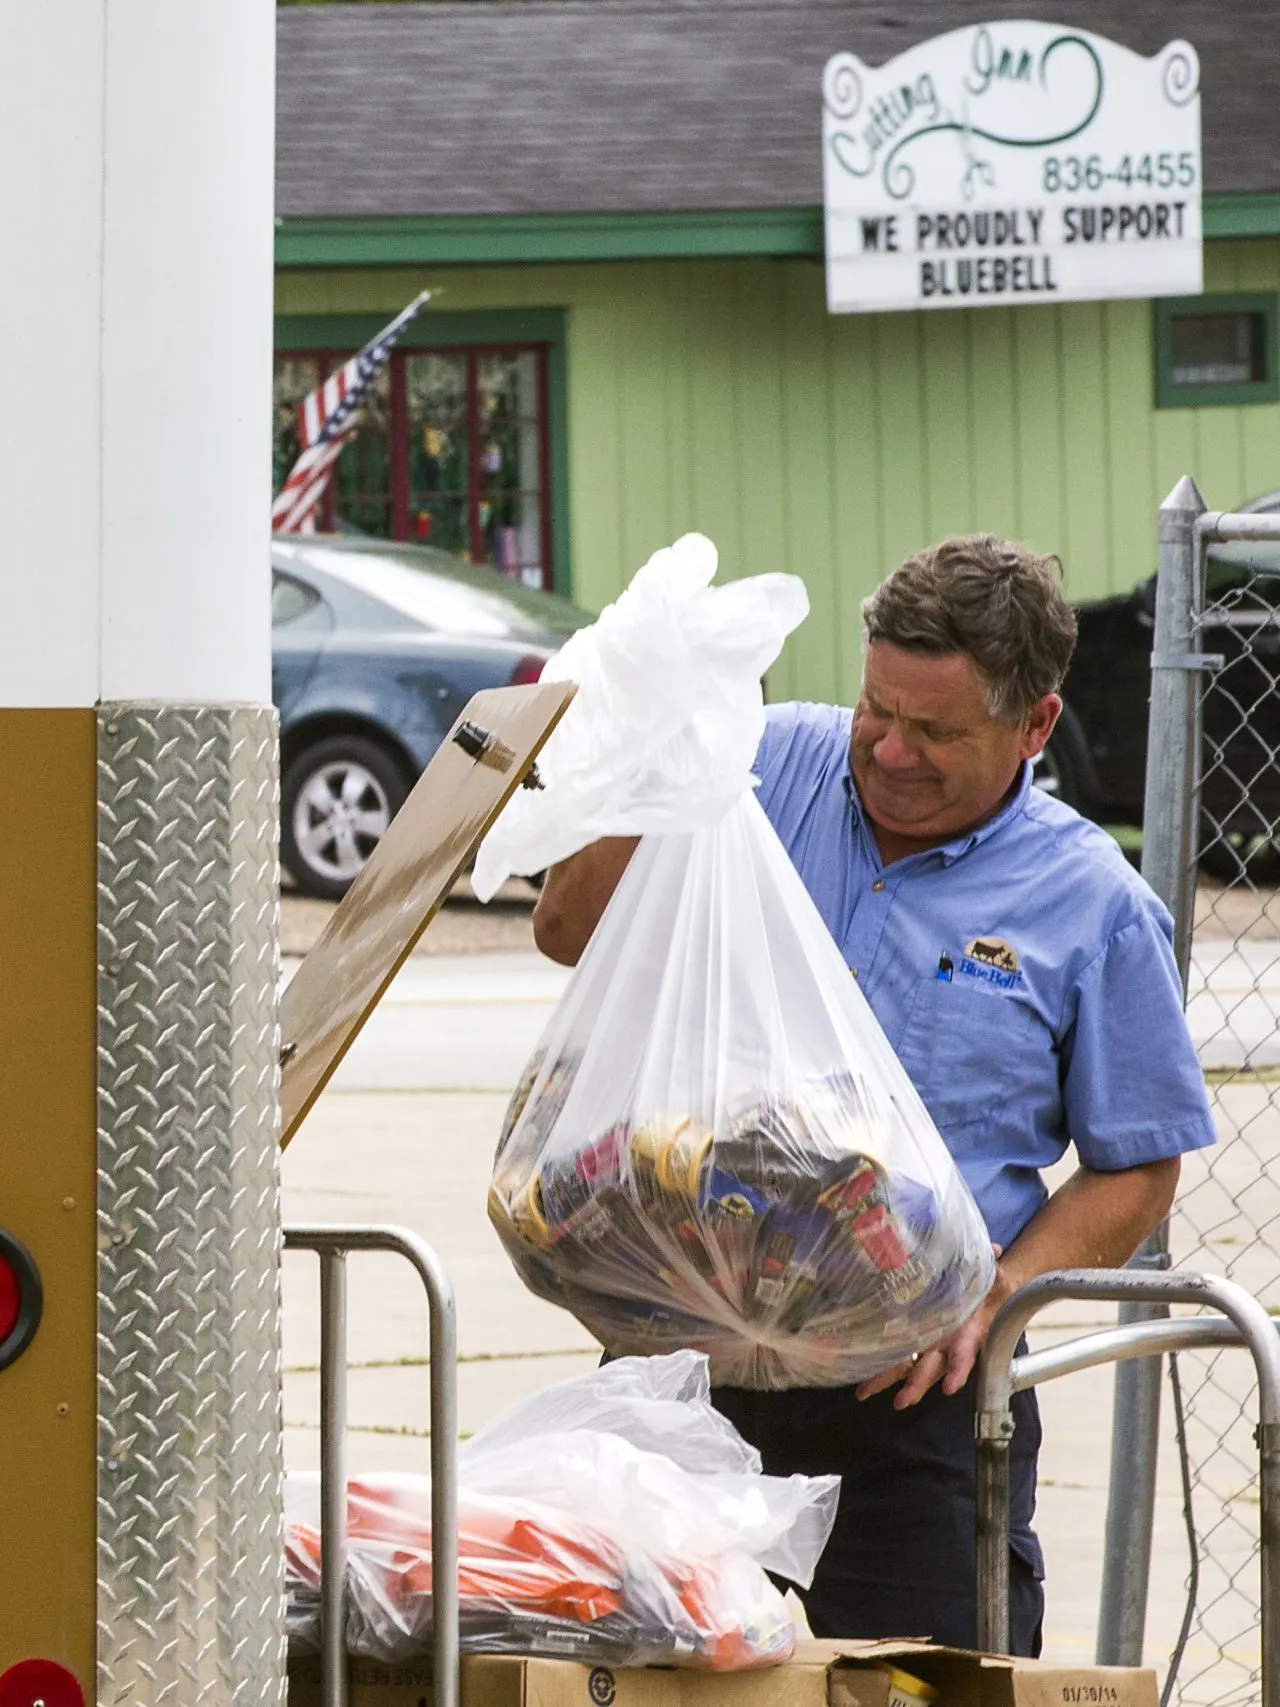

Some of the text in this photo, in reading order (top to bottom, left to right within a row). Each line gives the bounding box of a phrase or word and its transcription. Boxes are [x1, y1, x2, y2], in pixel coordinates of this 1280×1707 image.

[831, 24, 1031, 177] Cutting Inn
[1042, 152, 1196, 194] 836-4455
[859, 202, 1188, 253] WE PROUDLY SUPPORT
[920, 255, 1058, 298] BLUEBELL
